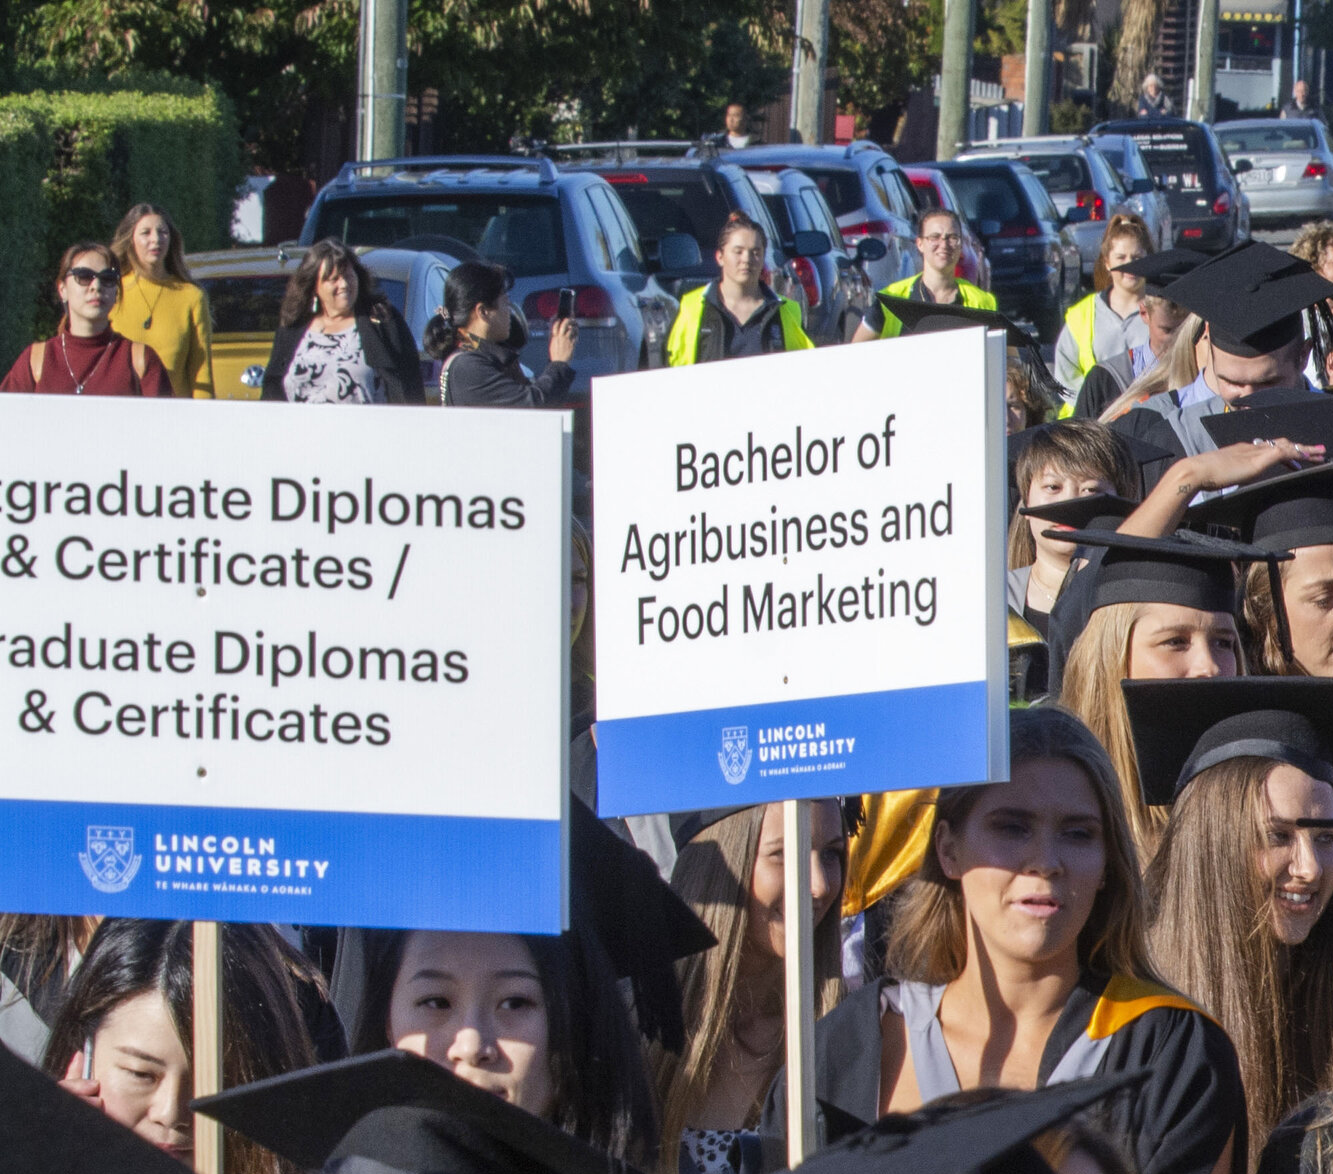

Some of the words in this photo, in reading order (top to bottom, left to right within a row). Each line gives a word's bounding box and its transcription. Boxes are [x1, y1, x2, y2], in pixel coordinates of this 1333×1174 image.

[676, 425, 846, 492] Bachelor
[857, 413, 896, 470] of
[0, 469, 253, 525] graduate
[271, 477, 526, 535] Diplomas
[620, 504, 870, 582] Agribusiness
[881, 482, 953, 543] and
[1, 533, 39, 579] &
[55, 535, 374, 591] Certificates
[387, 543, 411, 600] /
[638, 583, 729, 646] Food
[742, 567, 938, 633] Marketing
[214, 630, 470, 688] Diplomas
[18, 689, 56, 734] &
[73, 691, 392, 746] Certificates
[759, 723, 825, 744] LINCOLN
[759, 738, 855, 762] UNIVERSITY
[155, 834, 275, 855] LINCOLN
[155, 855, 329, 878] UNIVERSITY
[156, 881, 168, 890] TE
[172, 881, 209, 891] WHARE
[261, 886, 269, 894] O
[272, 886, 312, 895] AORAKI
